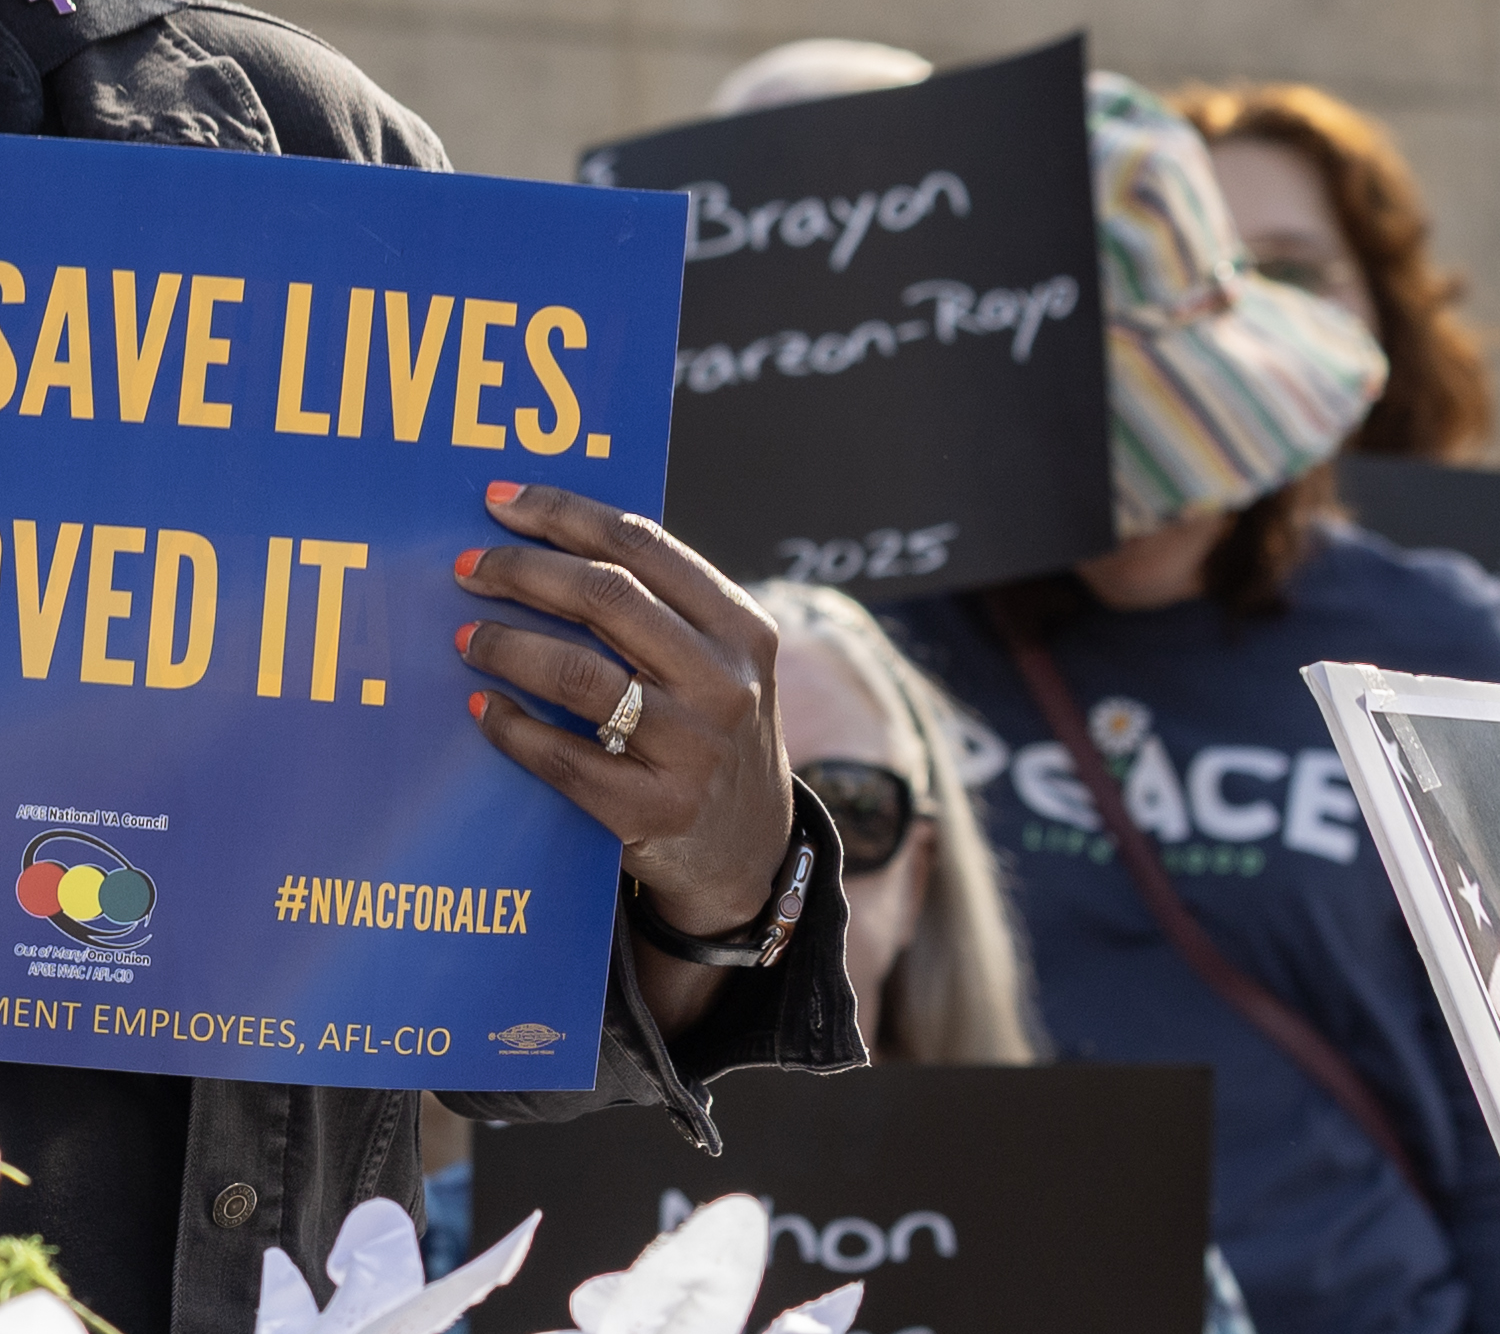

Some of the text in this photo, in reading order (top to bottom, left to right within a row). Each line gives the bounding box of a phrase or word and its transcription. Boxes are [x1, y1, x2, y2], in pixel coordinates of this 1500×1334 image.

[274, 282, 612, 459] LIVES.
[255, 536, 387, 707] IT.
[48, 806, 99, 825] National
[102, 810, 120, 827] VA
[122, 812, 169, 831] Council
[274, 874, 531, 934] #NVACFORALEX
[14, 943, 38, 958] Out
[115, 951, 151, 966] Union
[93, 1004, 305, 1053] EMPLOYEES,
[318, 1023, 451, 1056] AFL-CIO
